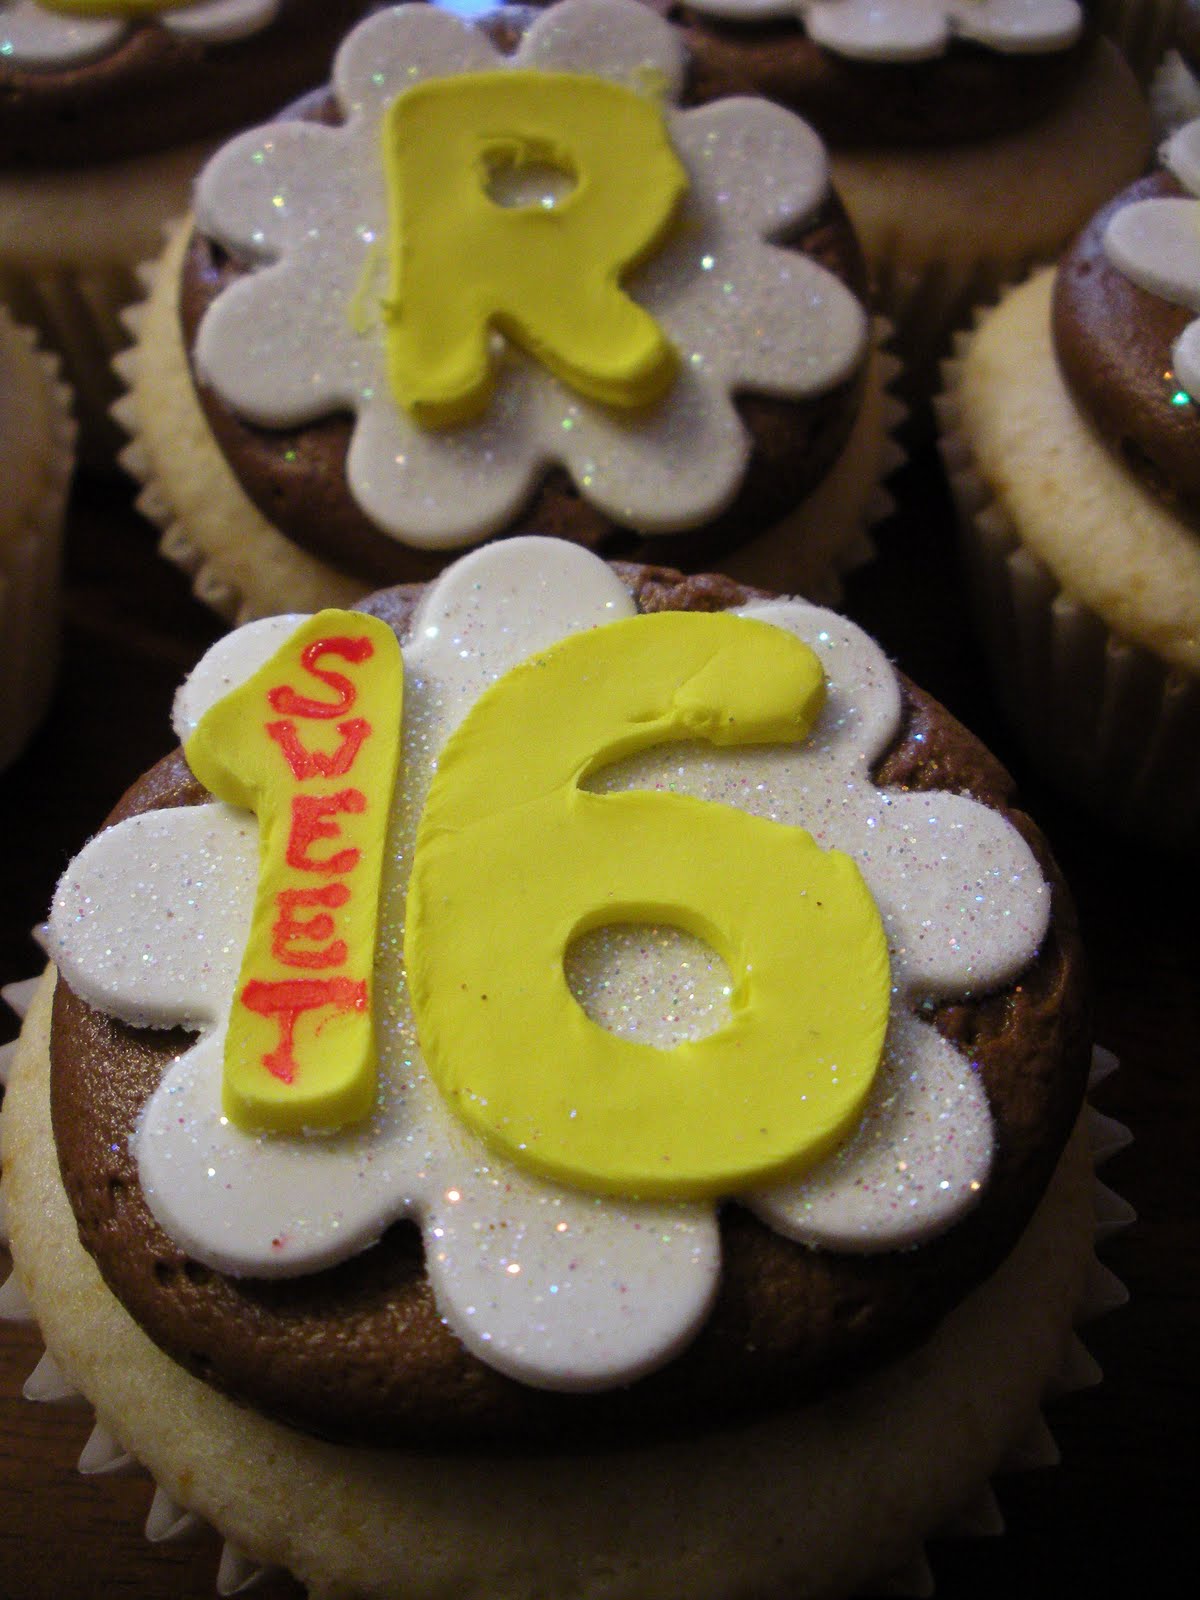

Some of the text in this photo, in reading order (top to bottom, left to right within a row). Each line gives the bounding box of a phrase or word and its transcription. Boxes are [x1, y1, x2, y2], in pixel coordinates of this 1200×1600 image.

[384, 70, 688, 427] R
[185, 608, 892, 1198] 16
[241, 635, 373, 1084] SWEET
